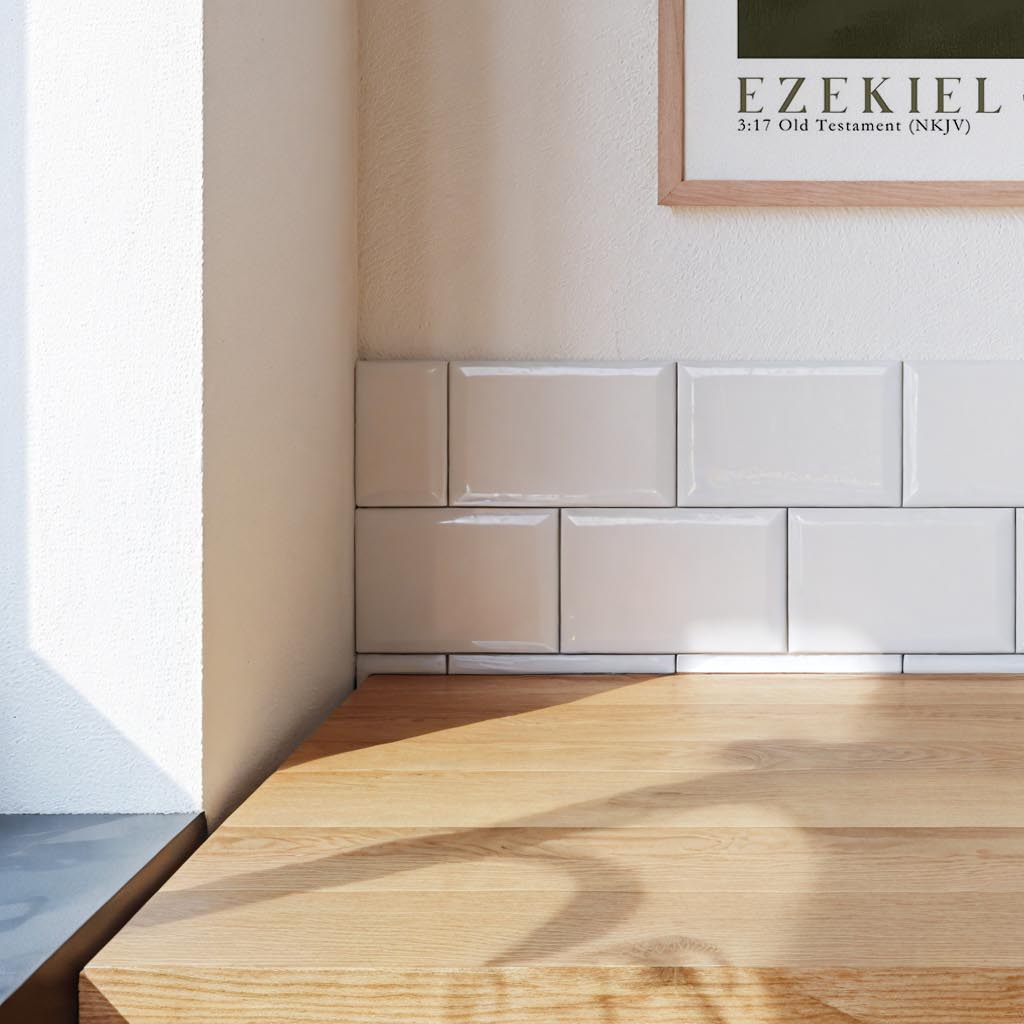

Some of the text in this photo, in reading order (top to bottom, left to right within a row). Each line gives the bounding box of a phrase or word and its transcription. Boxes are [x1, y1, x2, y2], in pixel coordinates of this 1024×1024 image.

[737, 76, 1002, 114] EZEKIEL
[737, 118, 971, 136] 3:17 Old Testament (NKJV)
